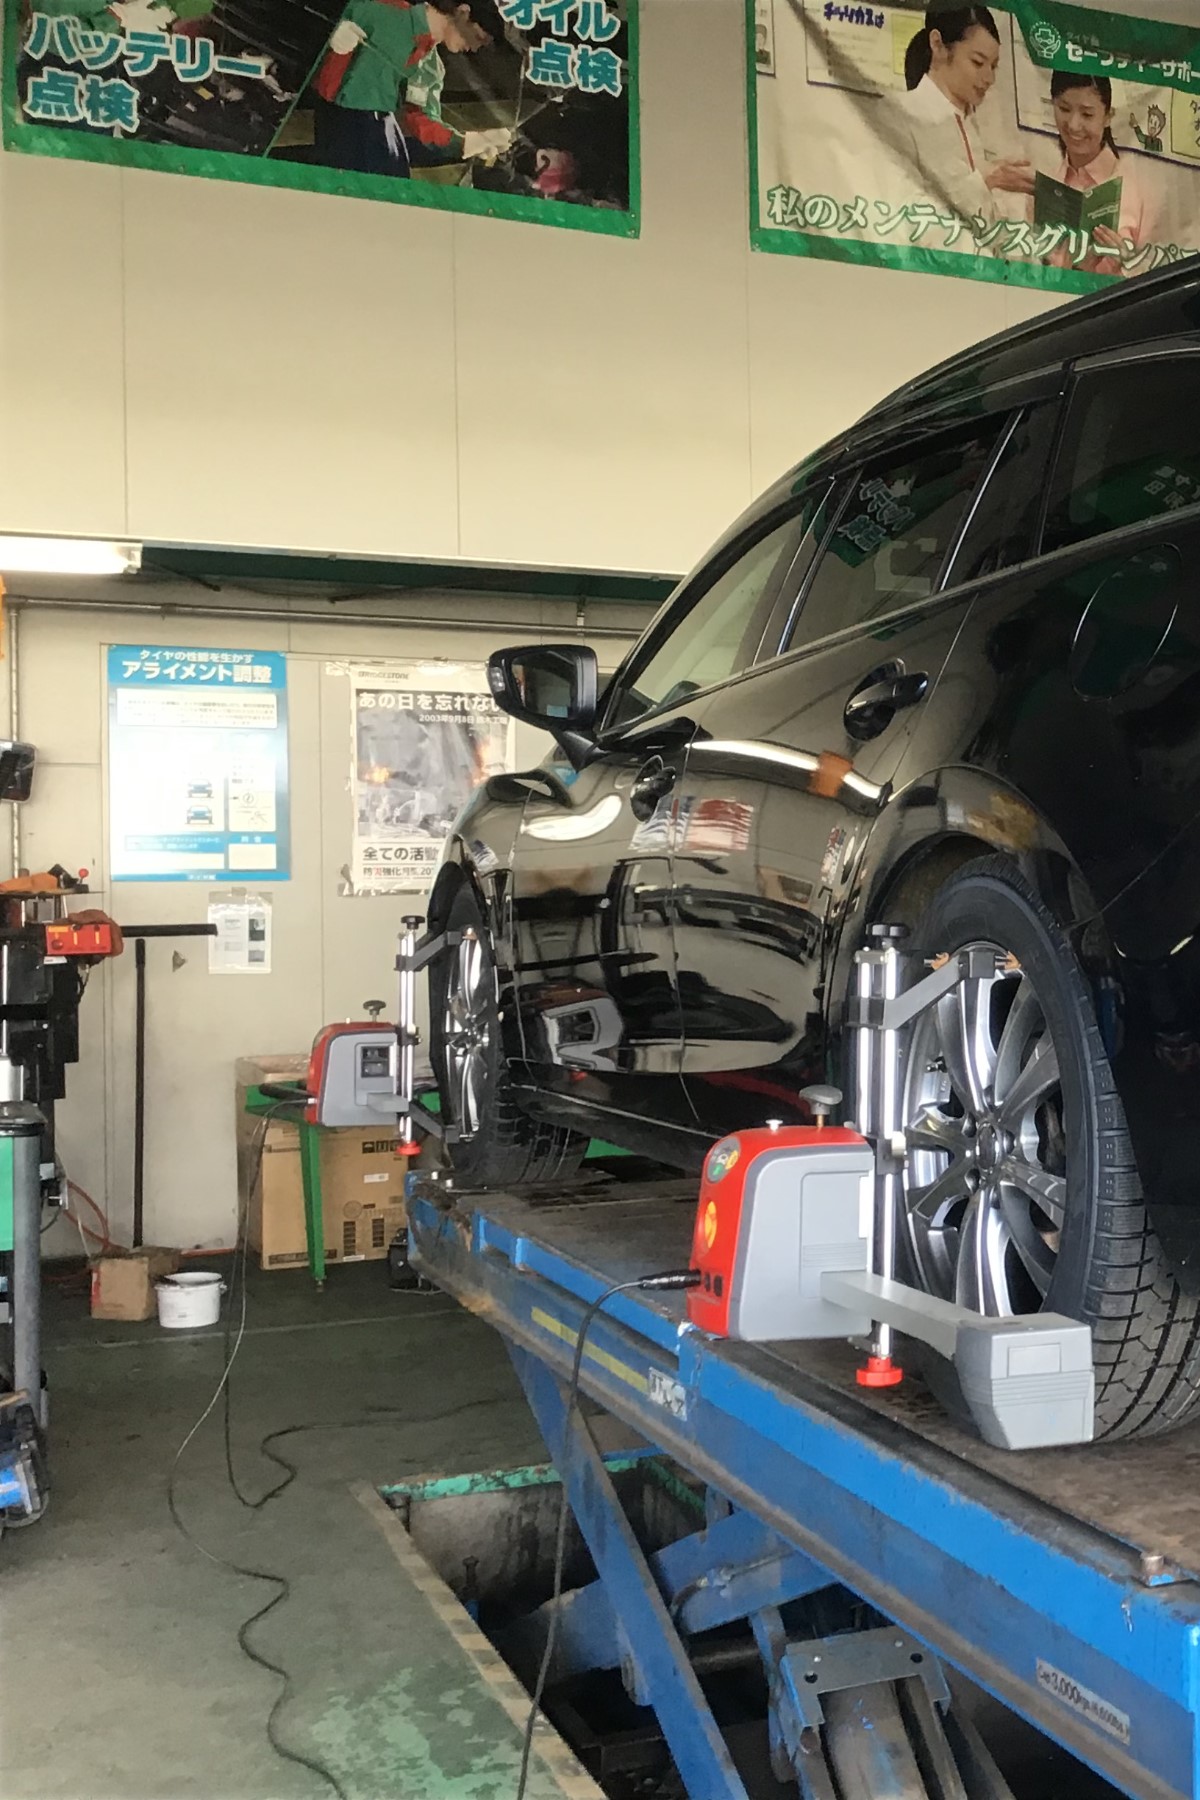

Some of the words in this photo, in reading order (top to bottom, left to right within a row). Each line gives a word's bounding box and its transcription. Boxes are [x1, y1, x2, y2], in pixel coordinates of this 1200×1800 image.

[24, 12, 265, 82] バッテリー
[496, 0, 621, 41] オイル
[526, 37, 622, 97] 点検
[23, 67, 140, 133] 点検
[767, 184, 1198, 270] 私のメンテナンスグリーンパ
[122, 660, 272, 684] アライメント調整
